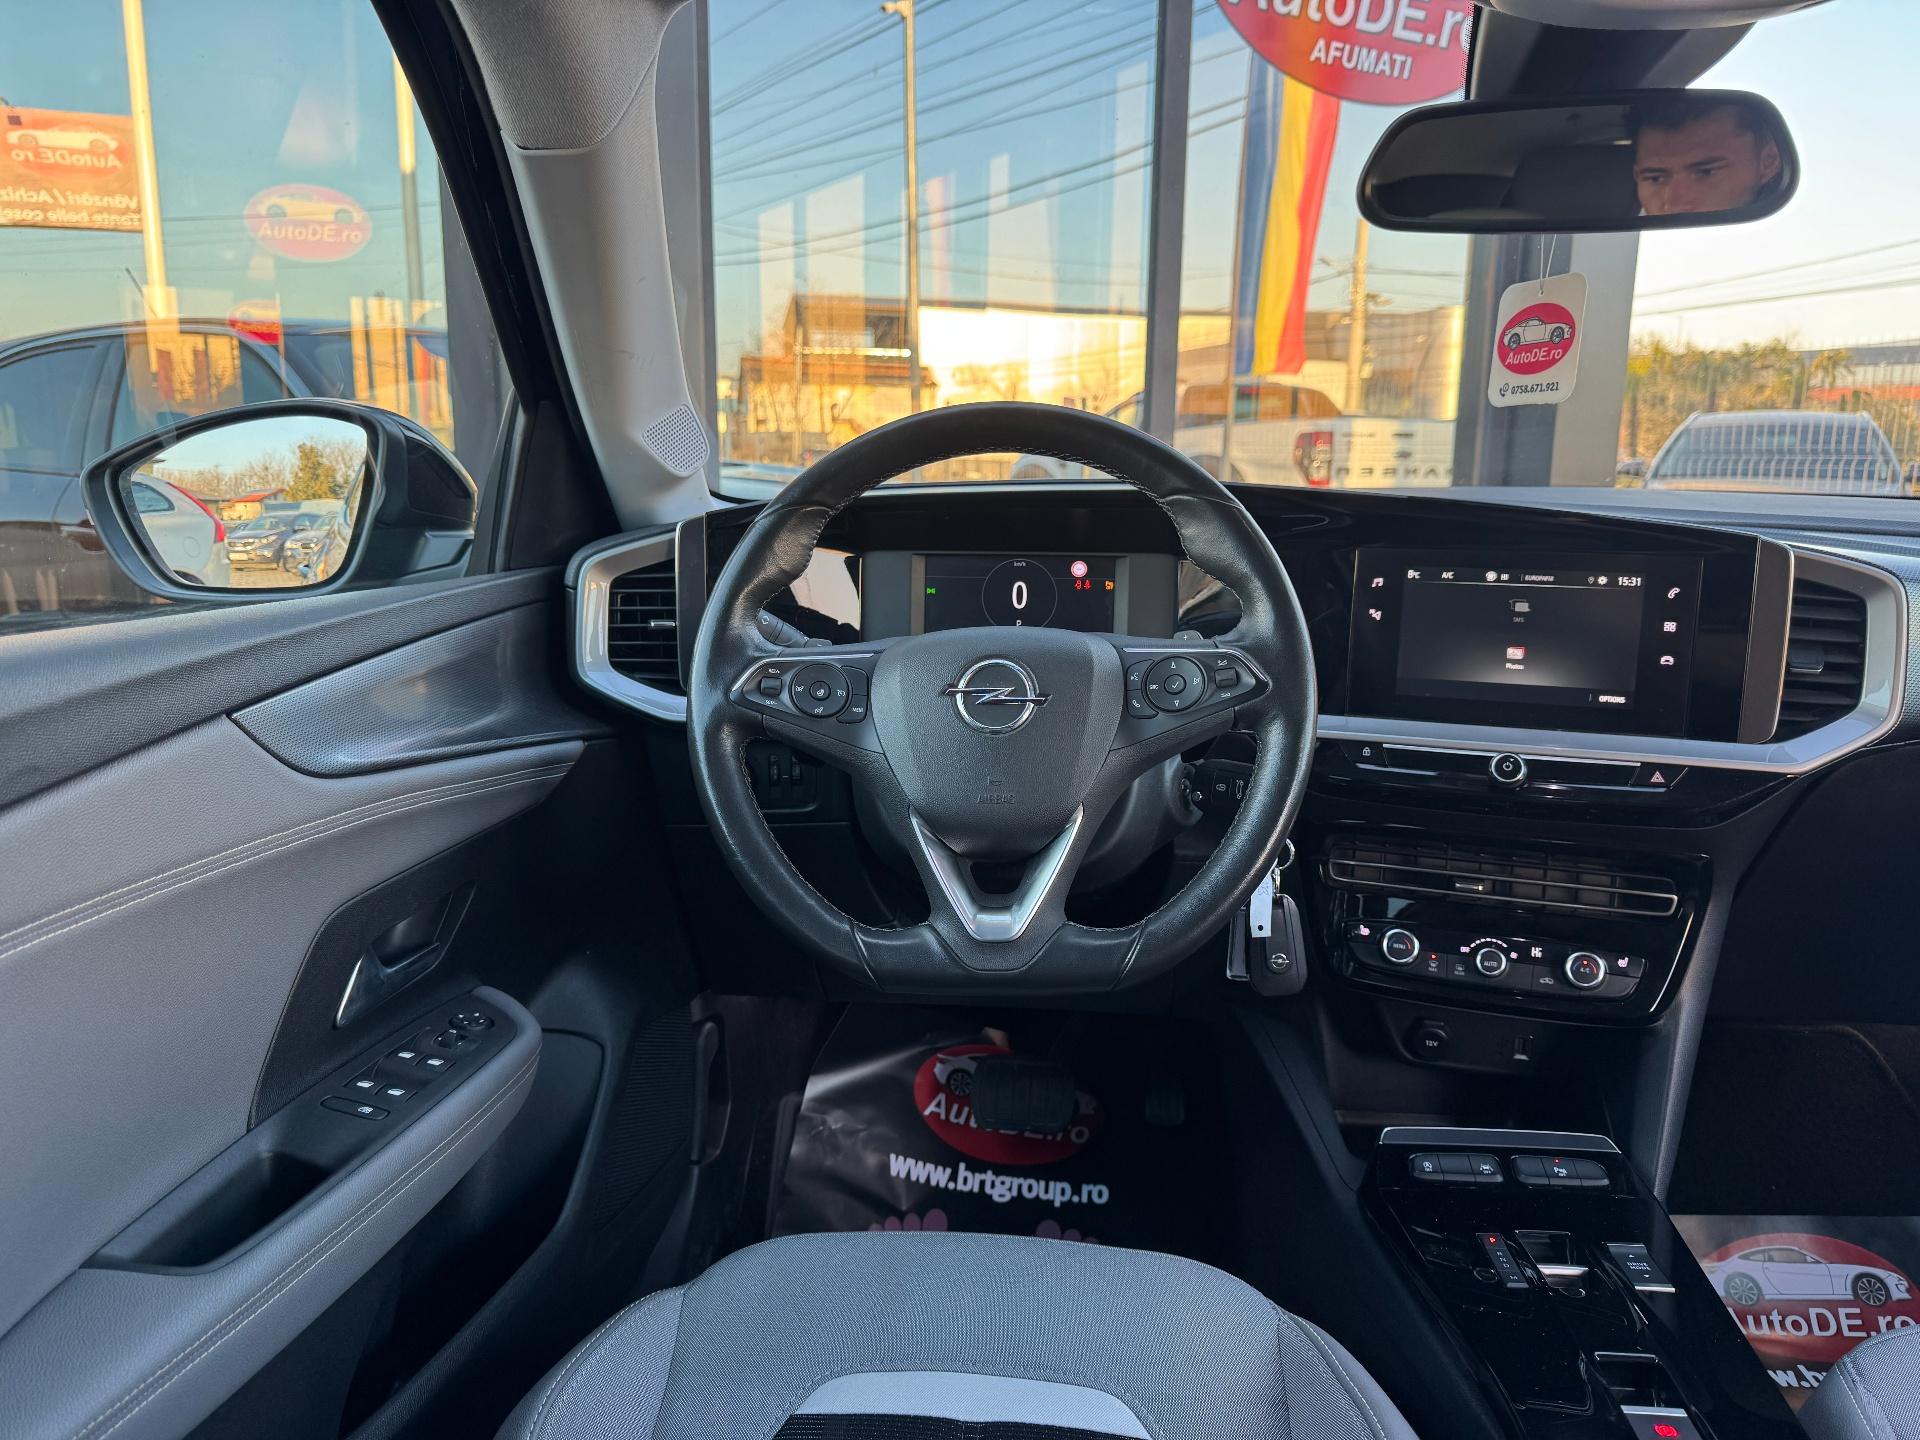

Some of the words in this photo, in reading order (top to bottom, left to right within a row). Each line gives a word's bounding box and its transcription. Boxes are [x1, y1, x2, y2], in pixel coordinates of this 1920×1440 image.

[1310, 37, 1413, 80] AFUMATI
[258, 223, 362, 243] AutoDE.ro
[1505, 347, 1562, 366] AutoDE.ro
[1511, 382, 1560, 395] 0758.671.921
[1618, 576, 1642, 587] 15:31
[1012, 581, 1028, 609] 0
[1016, 619, 1022, 627] P
[1599, 695, 1626, 704] OPTIONS
[1484, 960, 1498, 968] AUTO
[889, 1152, 1110, 1207] www.brtgroup.ro
